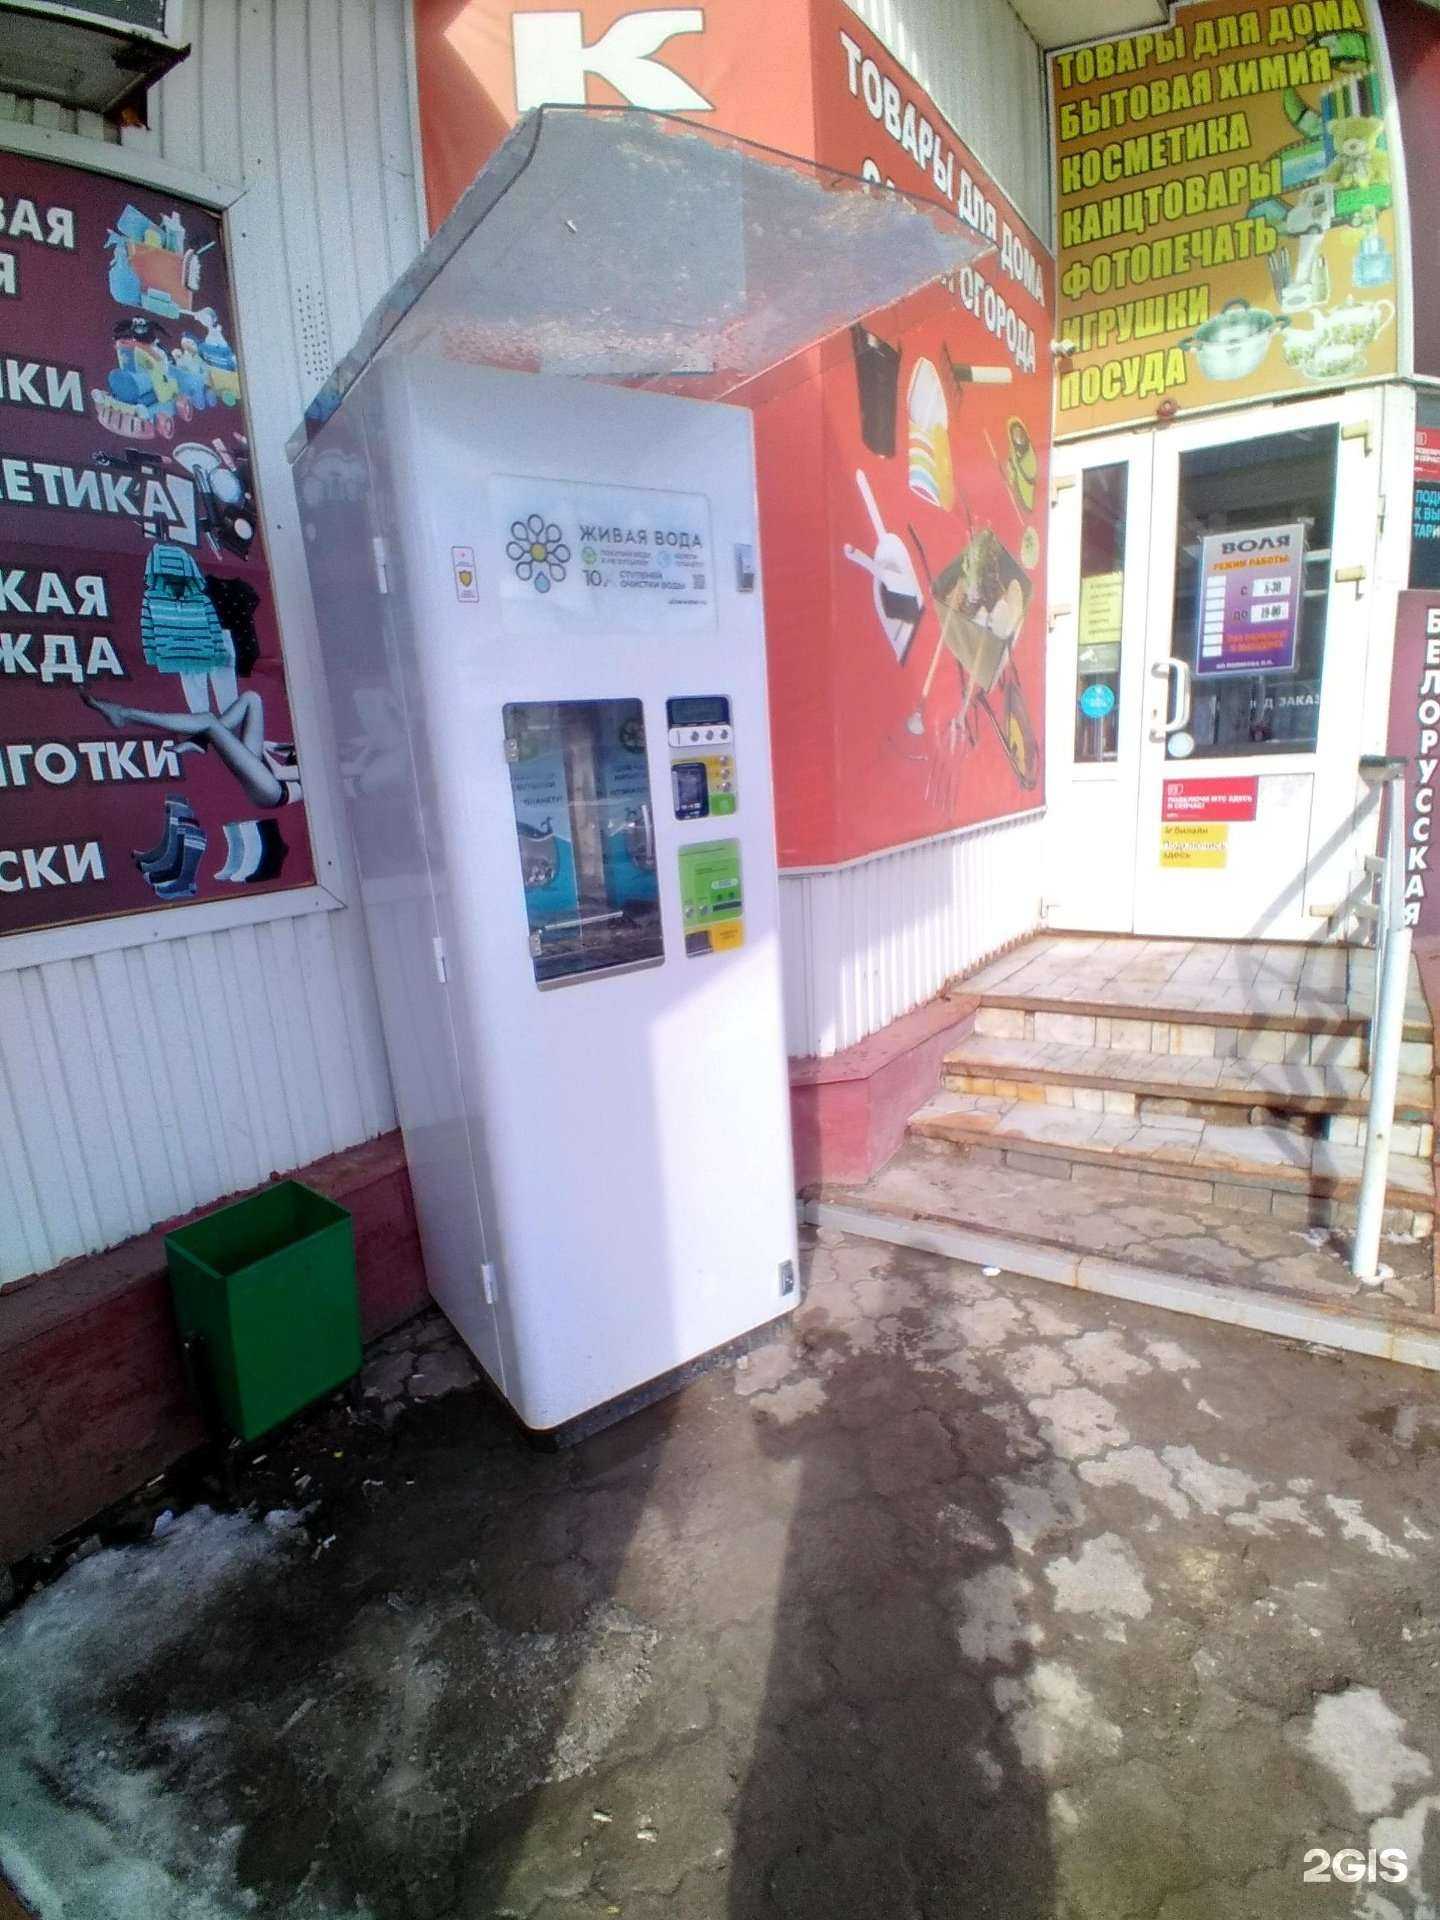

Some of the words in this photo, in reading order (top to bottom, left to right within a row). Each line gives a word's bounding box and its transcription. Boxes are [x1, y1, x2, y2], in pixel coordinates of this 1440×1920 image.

[512, 10, 715, 111] К
[1057, 25, 1185, 89] ТОВАРЫ
[1193, 11, 1260, 60] ДЛЯ
[1268, 0, 1364, 45] ДОМА
[1060, 69, 1213, 141] БЫТОВАЯ
[1217, 46, 1332, 100] ХИМИЯ
[839, 28, 955, 202] ТОВАРЫ
[957, 168, 998, 242] ДЛЯ
[1001, 221, 1046, 308] ДОМА
[1061, 111, 1250, 195] КОСМЕТИКА
[1061, 156, 1283, 249] КАНЦТОВАРЫ
[1060, 216, 1278, 300] ФОТОПЕЧАТЬ
[959, 266, 1036, 374] ОГОРОДА
[1060, 285, 1211, 353] ИГРУШКИ
[0, 359, 84, 412] КИ
[1060, 348, 1187, 411] ПОСУДА
[0, 458, 177, 523] ЕТИКА
[579, 525, 648, 545] ЖИВАЯ
[654, 529, 703, 550] ВОДА
[1222, 535, 1290, 554] ВОЛЯ
[0, 570, 108, 616] КАЯ
[0, 632, 125, 684] ЖДА
[0, 740, 181, 787] ГОТКИ
[1402, 607, 1440, 927] БЕЛОРУССКАЯ
[0, 842, 105, 892] СКИ
